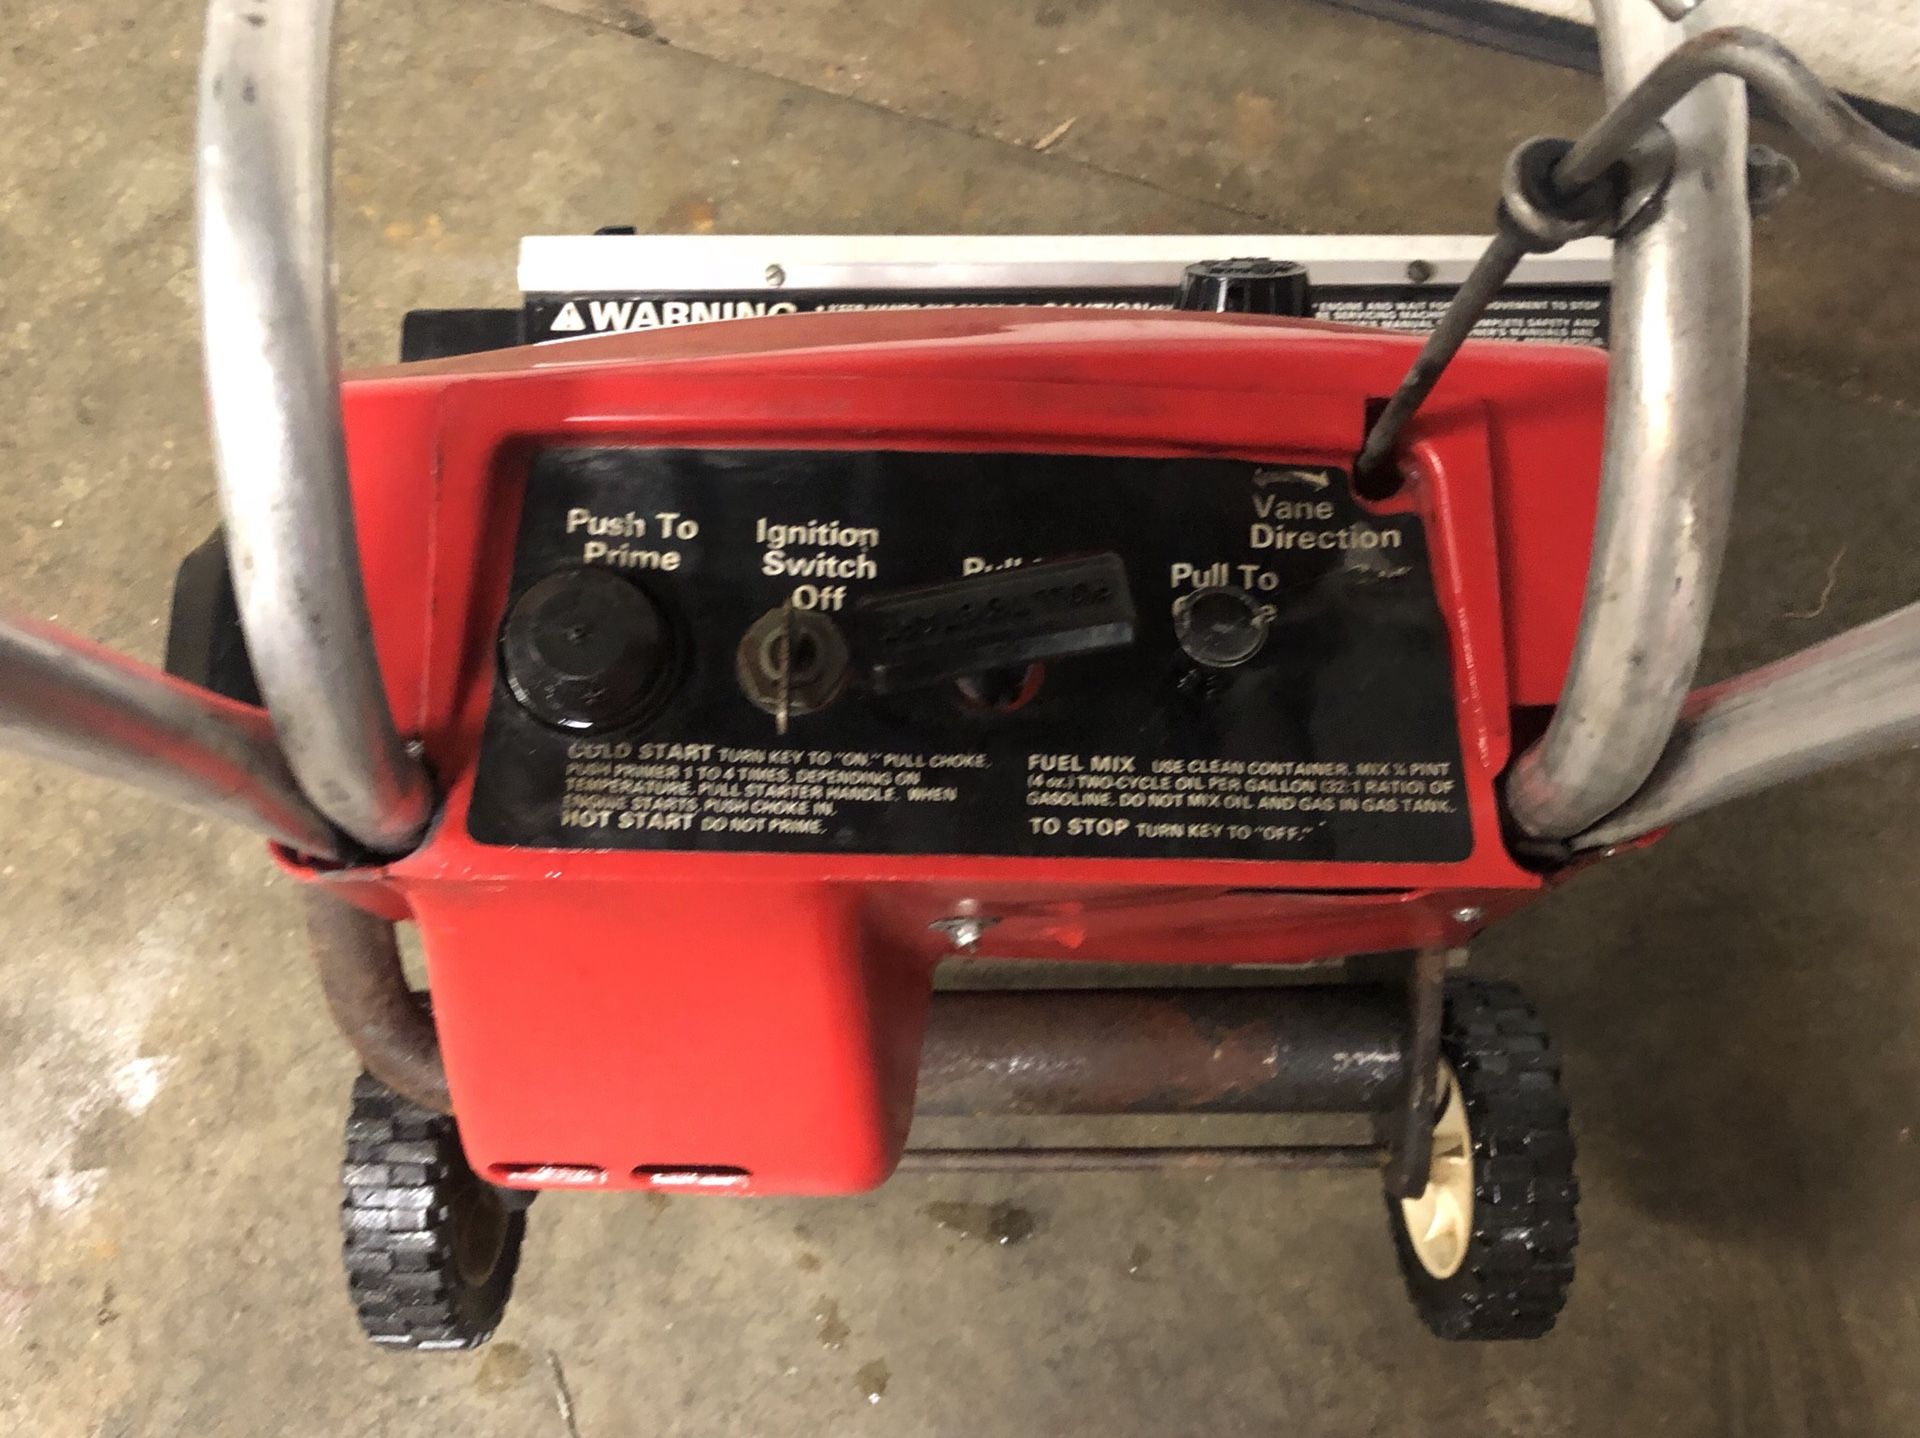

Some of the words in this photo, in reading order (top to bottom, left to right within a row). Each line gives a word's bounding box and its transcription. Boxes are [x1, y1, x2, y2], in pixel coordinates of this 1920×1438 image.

[1253, 494, 1334, 519] Vane
[566, 507, 646, 538] Push
[655, 512, 699, 540] To
[756, 517, 879, 549] Ignition
[1250, 523, 1401, 550] Direction
[583, 541, 682, 572] Prime
[762, 550, 878, 580] Switch
[1170, 562, 1229, 590] Pull
[1237, 564, 1280, 591] To
[792, 584, 847, 611] Off
[567, 742, 633, 759] COLD
[638, 743, 715, 761] START
[717, 747, 766, 764] TURN
[768, 750, 805, 764] KEY
[807, 751, 832, 765] TO
[883, 753, 928, 768] PULL
[1027, 753, 1085, 771] FUEL
[1090, 755, 1137, 773] MIX
[1151, 759, 1185, 774] USE
[1187, 759, 1245, 775] CLEAN
[1355, 762, 1391, 776] MIX
[1409, 762, 1450, 776] PINT
[613, 763, 680, 779] PRIMER
[683, 765, 693, 780] 1
[697, 765, 722, 781] TO
[723, 766, 736, 781] 4
[795, 769, 893, 786] DEPENDING
[894, 771, 921, 786] ON
[1077, 774, 1174, 790] TWO-CYCLE
[1174, 776, 1207, 791] OIL
[1208, 776, 1242, 792] PER
[1244, 778, 1317, 794] GALLON
[1429, 780, 1455, 795] OF
[697, 781, 742, 797] PULL
[743, 783, 824, 800] STARTER
[907, 786, 958, 802] WHEN
[1119, 792, 1146, 808] DO
[1147, 792, 1185, 808] NOT
[1187, 793, 1222, 809] MIX
[1223, 793, 1254, 809] OIL
[1257, 795, 1297, 811] AND
[1298, 796, 1336, 812] GAS
[1339, 797, 1360, 812] IN
[1361, 798, 1399, 813] GAS
[703, 798, 750, 813] PUSH
[750, 799, 810, 815] CHOKE
[561, 809, 614, 828] HOT
[618, 811, 699, 831] START
[701, 816, 728, 832] DO
[729, 816, 768, 833] NOT
[1029, 816, 1061, 835] TO
[1066, 817, 1131, 836] STOP
[1135, 822, 1186, 838] TURN
[1187, 823, 1225, 839] KEY
[1226, 824, 1252, 840] TO
